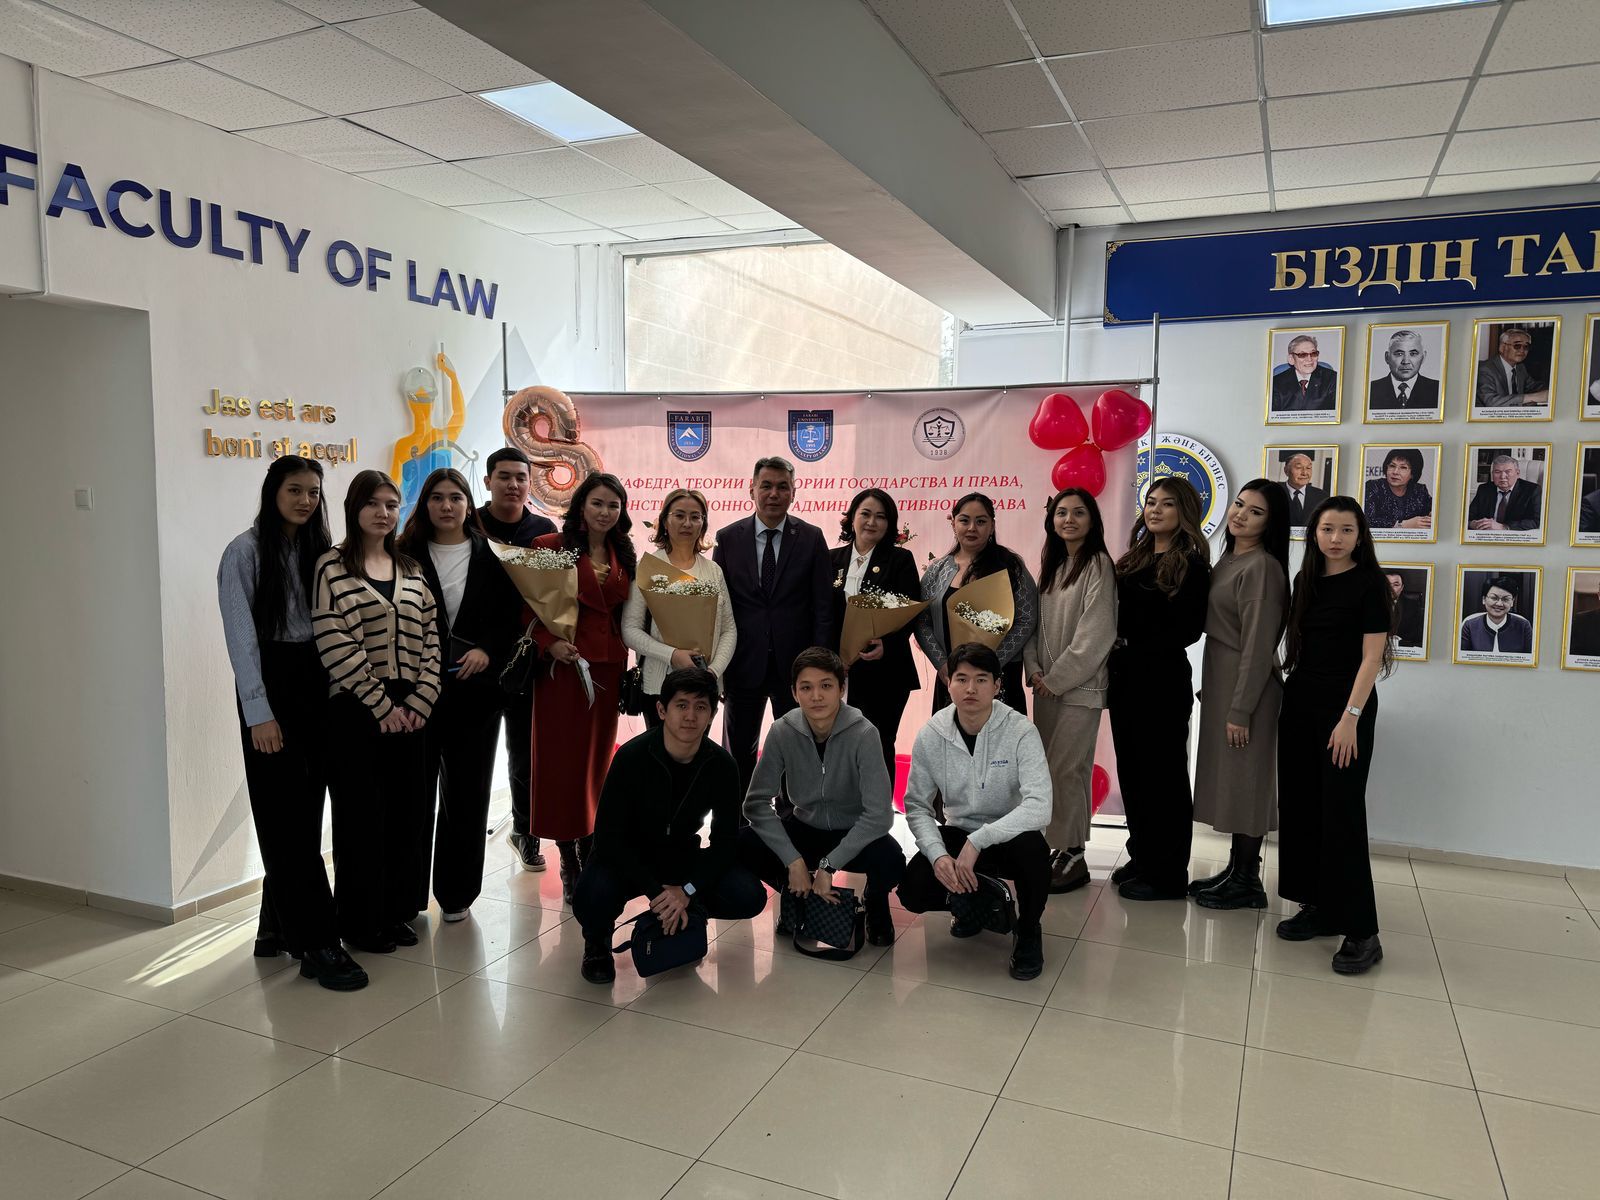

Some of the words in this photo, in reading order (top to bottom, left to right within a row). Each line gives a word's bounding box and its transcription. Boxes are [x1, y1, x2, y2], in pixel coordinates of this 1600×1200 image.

[0, 144, 311, 273] FACULTY
[327, 240, 392, 292] OF
[408, 259, 498, 319] LAW
[1269, 238, 1480, 296] БІЗДІҢ
[258, 397, 295, 421] est
[302, 403, 336, 424] ars
[205, 427, 262, 458] boni
[270, 437, 292, 459] et
[620, 477, 680, 491] АФЕДРА
[685, 477, 744, 490] ТЕОРИИ
[840, 476, 948, 490] ГОСУДАРСТВА
[952, 476, 965, 488] И
[968, 475, 1024, 489] ПРАВА,
[1198, 449, 1226, 490] БИЗНЕС
